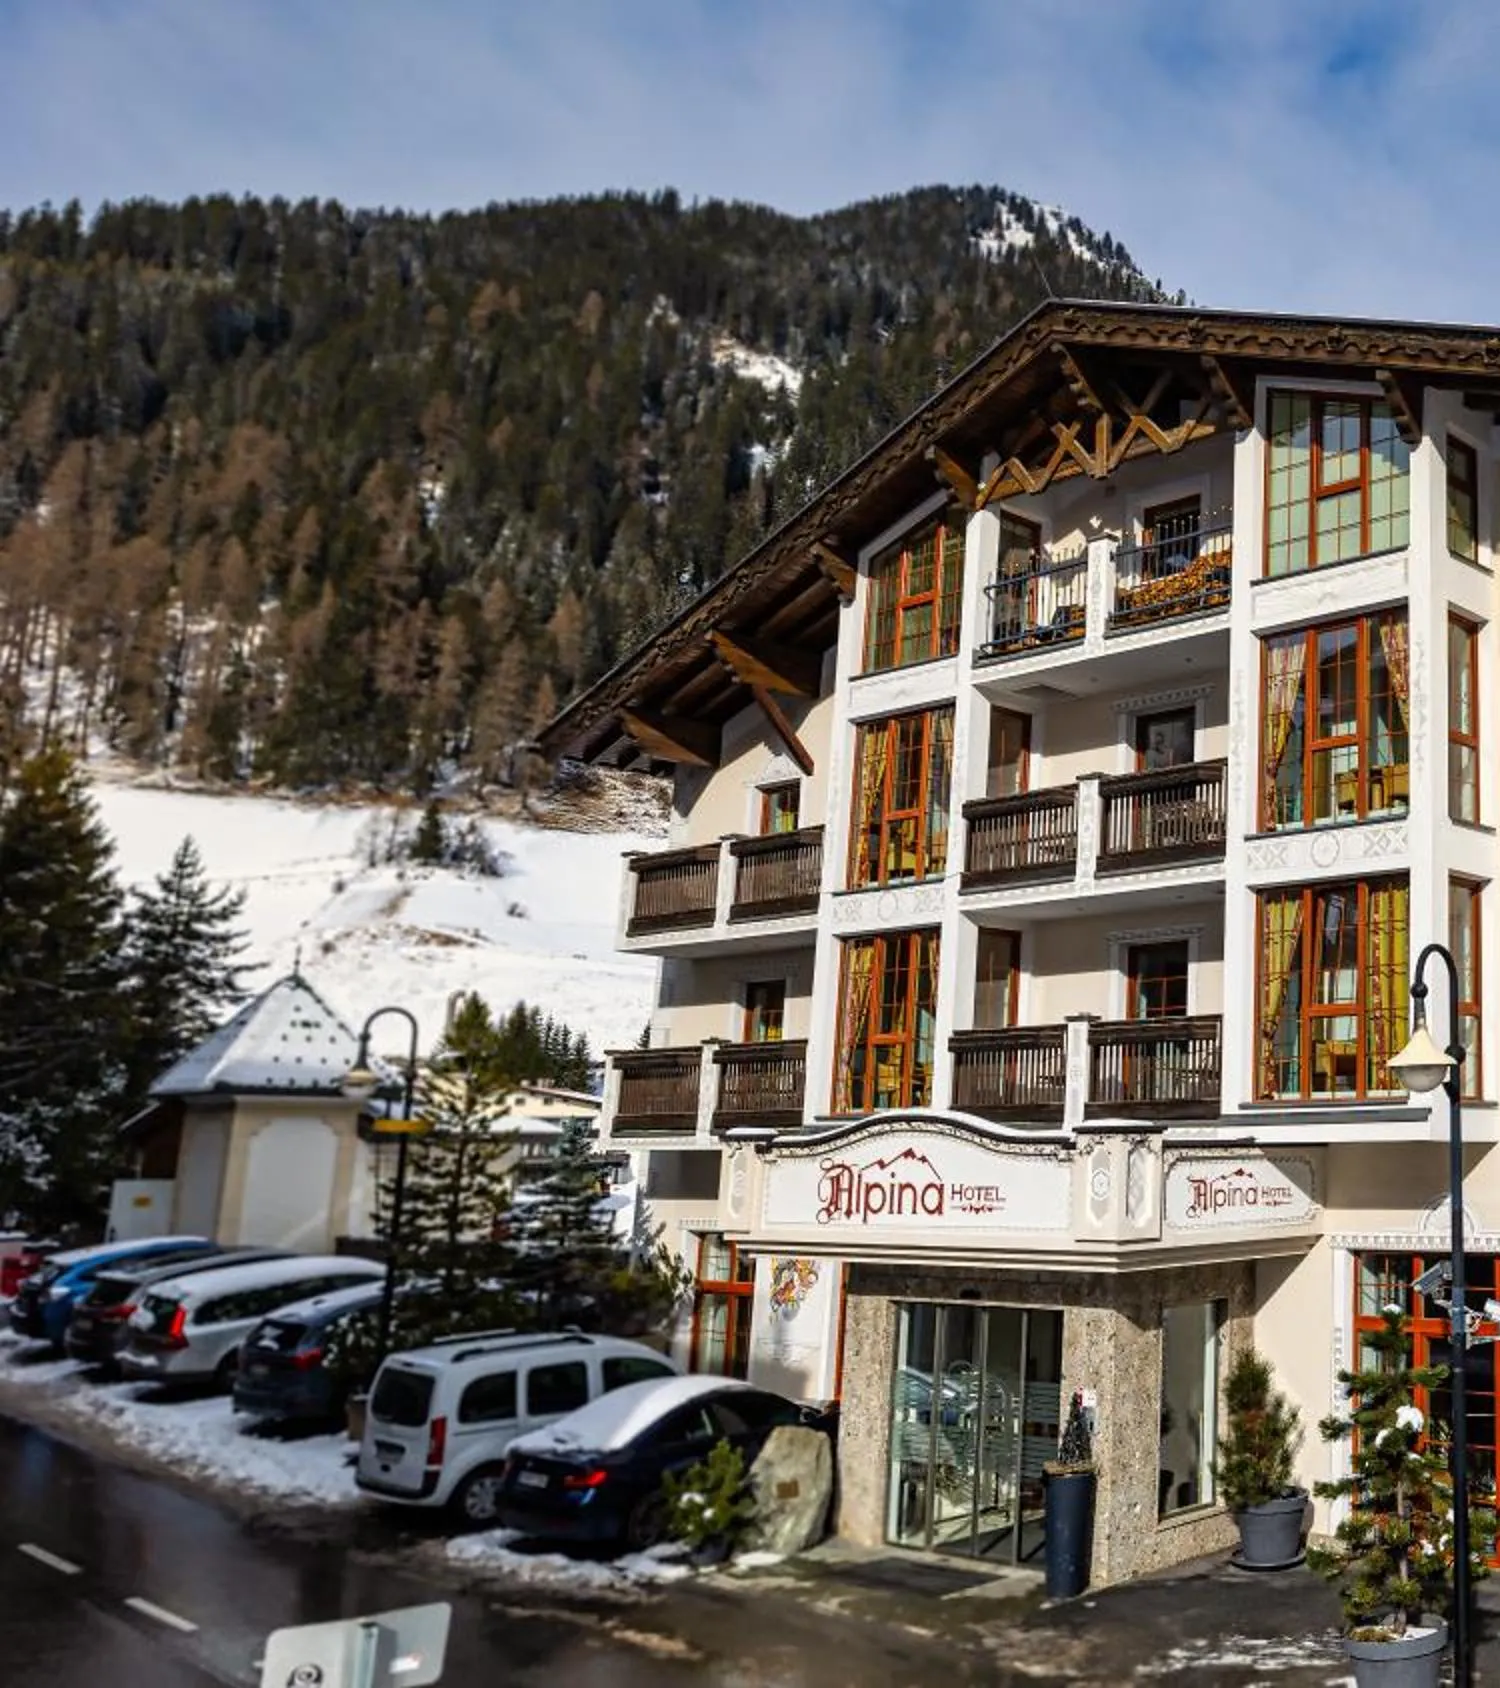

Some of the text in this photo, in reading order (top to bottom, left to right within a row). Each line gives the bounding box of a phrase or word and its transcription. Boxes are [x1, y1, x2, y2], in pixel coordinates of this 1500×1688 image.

[816, 1157, 1007, 1225] Alpina HOTEL
[1186, 1175, 1294, 1219] Alpina HOTEL
